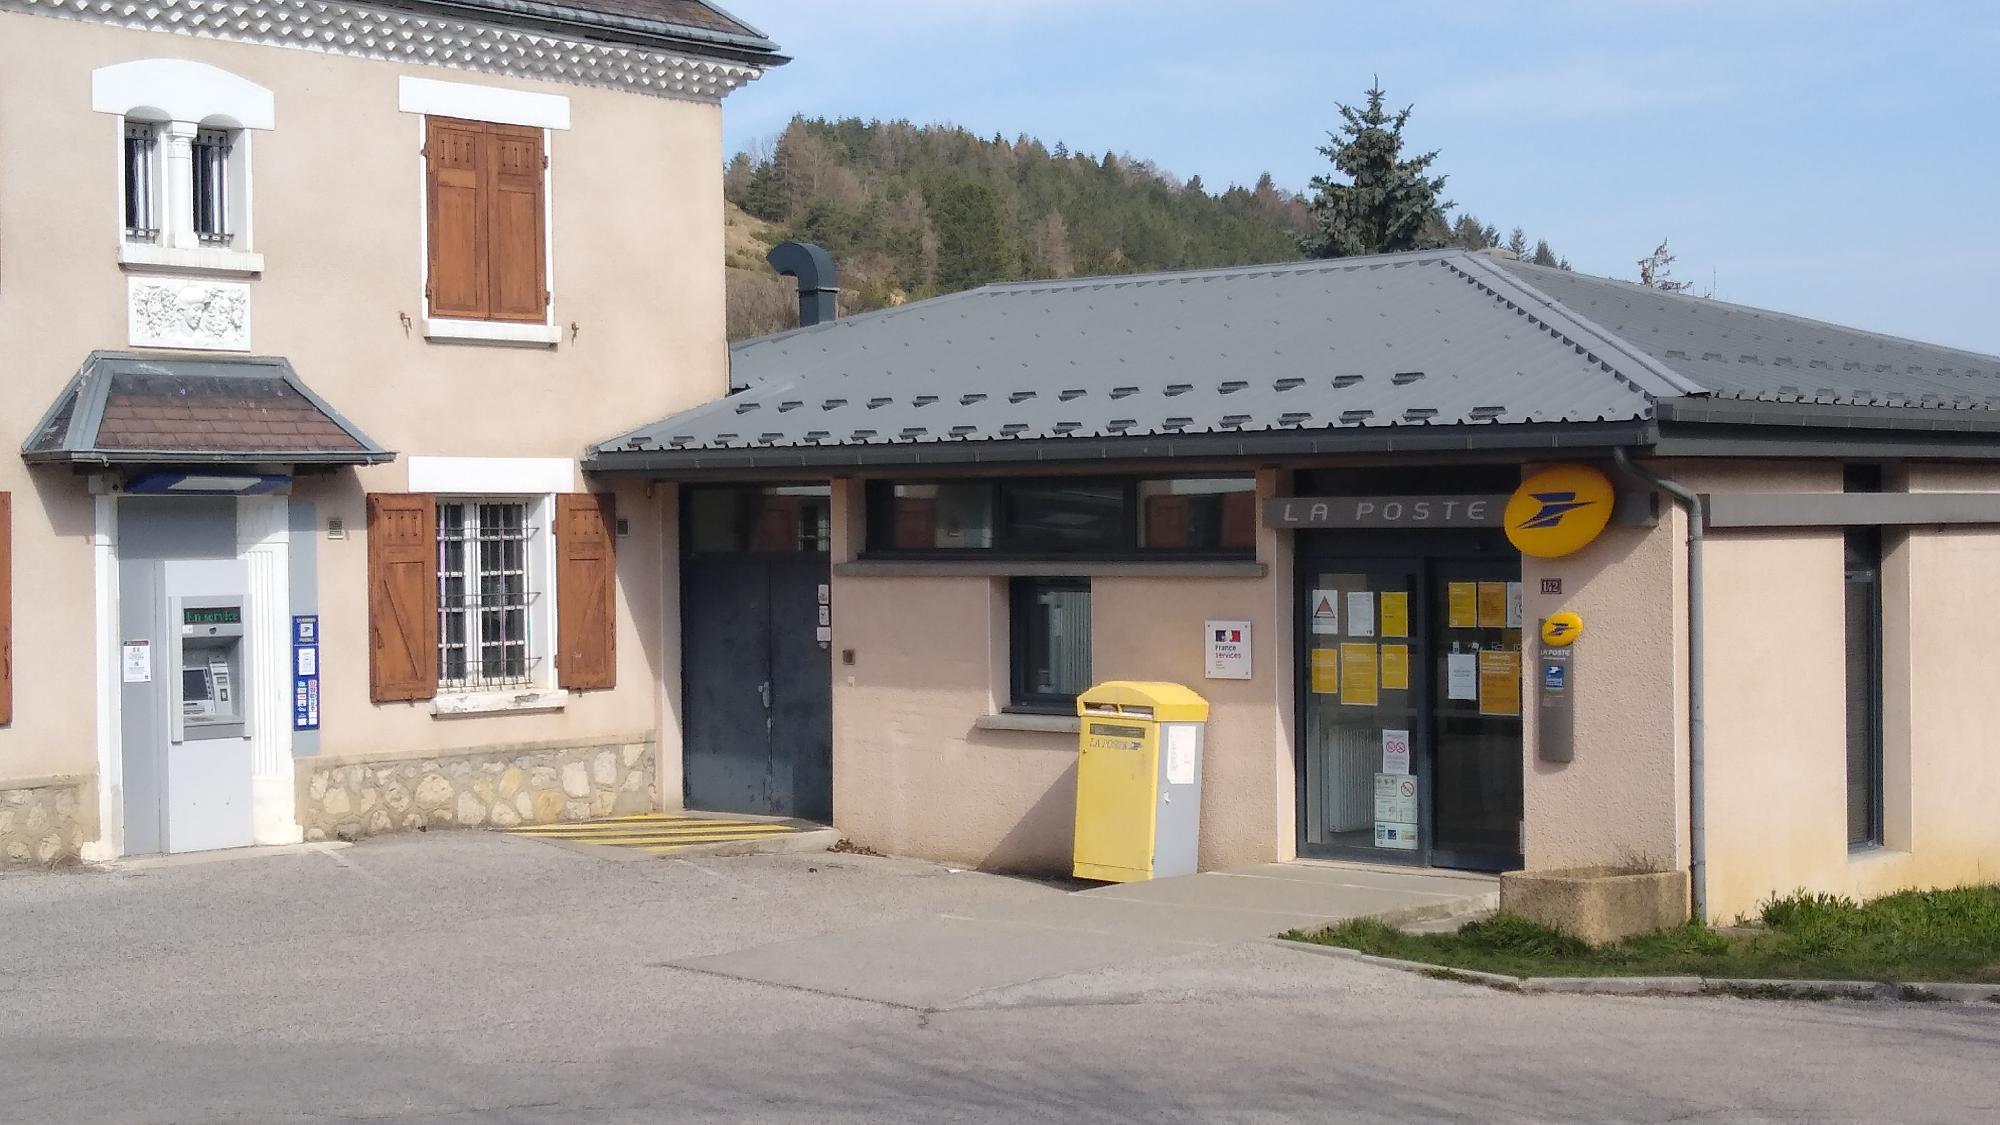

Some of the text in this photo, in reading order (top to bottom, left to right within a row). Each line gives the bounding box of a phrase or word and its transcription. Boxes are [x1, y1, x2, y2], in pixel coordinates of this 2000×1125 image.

[1283, 501, 1487, 521] LA POSTE
[186, 611, 238, 622] En service
[1548, 649, 1571, 657] POSTE
